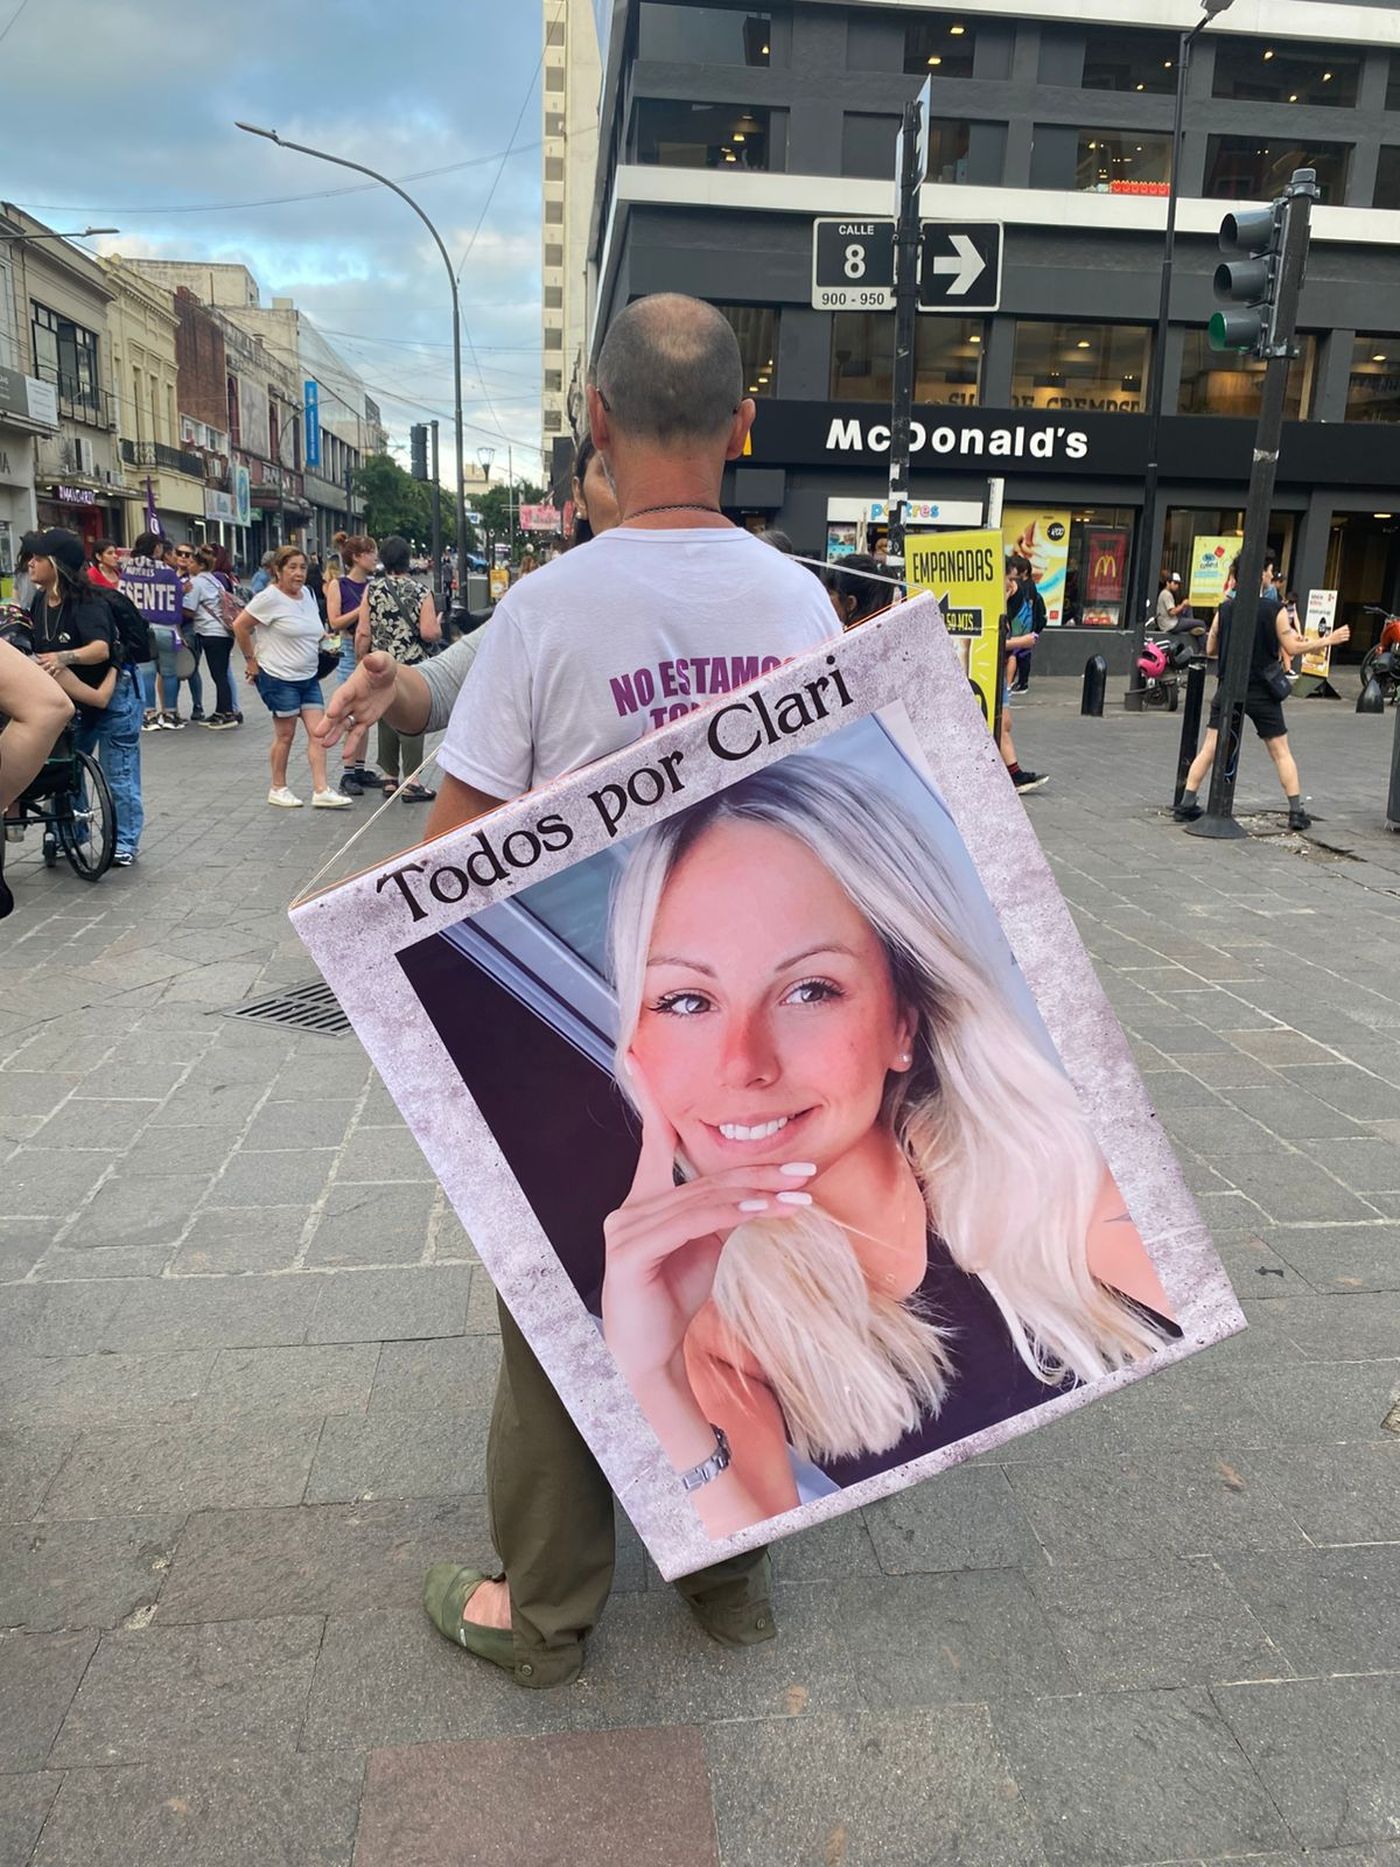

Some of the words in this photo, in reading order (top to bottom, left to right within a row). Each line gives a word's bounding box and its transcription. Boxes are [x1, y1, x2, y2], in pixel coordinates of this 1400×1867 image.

[838, 225, 875, 236] CALLE
[844, 244, 866, 279] 8
[821, 293, 846, 306] 900
[860, 293, 885, 306] 950
[826, 418, 1088, 458] McDonald's
[871, 503, 940, 520] potres
[913, 549, 994, 584] EMPANADAS
[609, 667, 655, 717] NO
[658, 655, 797, 699] ESTAM
[376, 814, 574, 922] Todos
[588, 750, 686, 838] por
[707, 655, 854, 761] Clari
